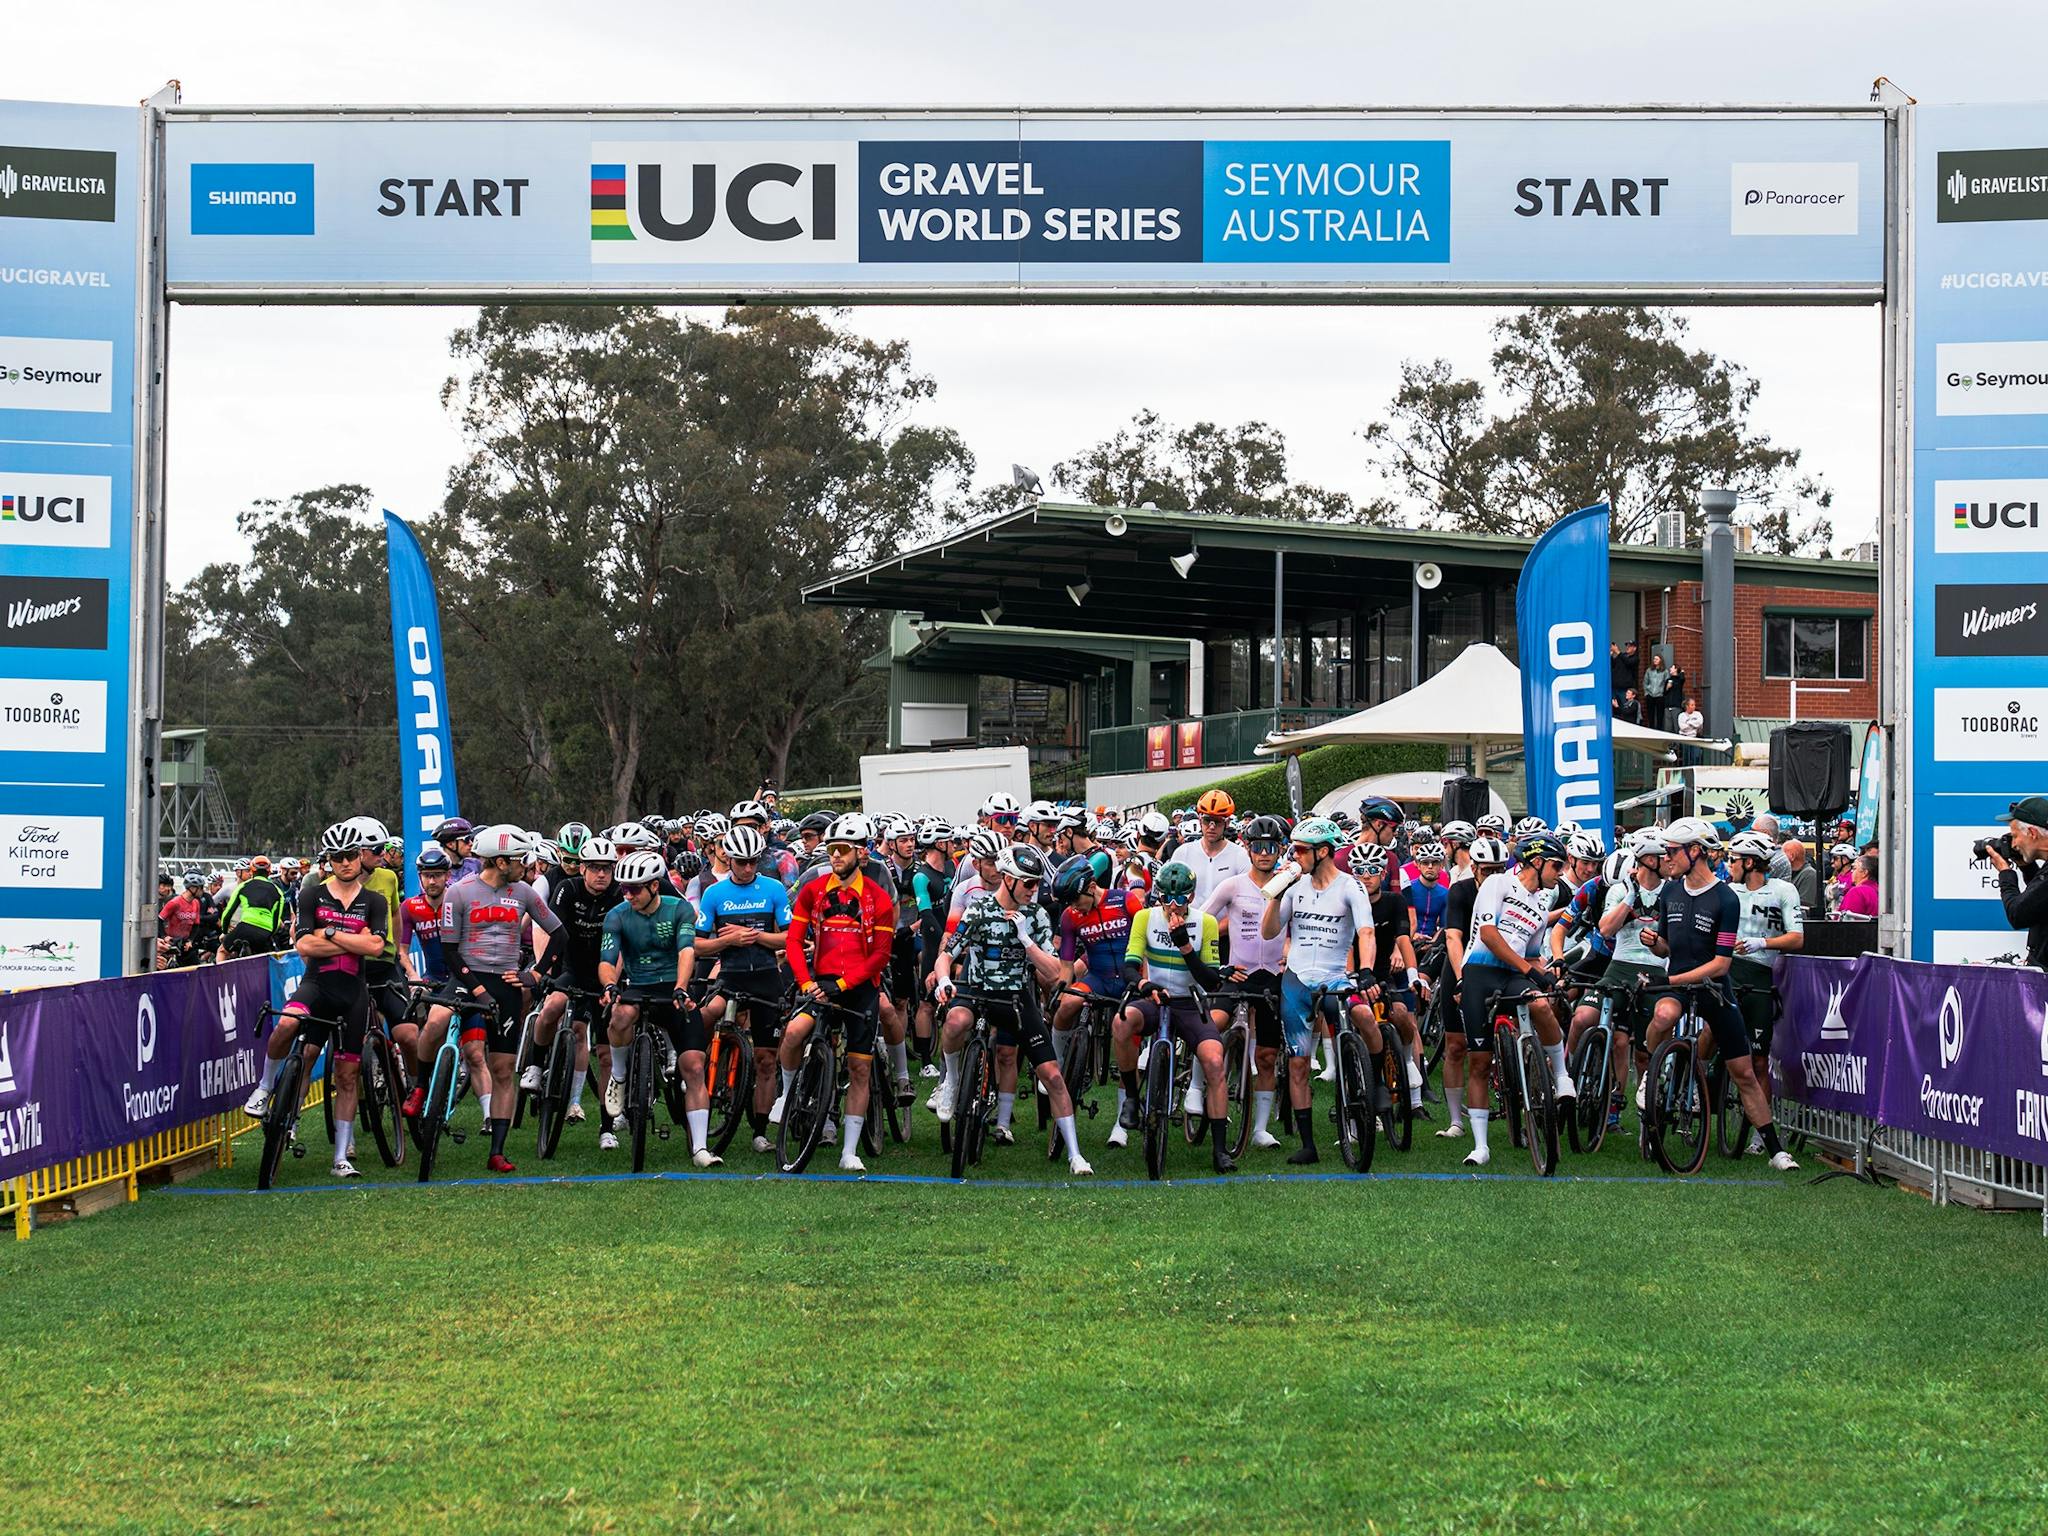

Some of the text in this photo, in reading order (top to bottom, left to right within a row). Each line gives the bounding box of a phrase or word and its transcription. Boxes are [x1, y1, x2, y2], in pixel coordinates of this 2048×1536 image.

[21, 174, 106, 194] GRAVELISTA
[879, 162, 1044, 195] GRAVEL
[1224, 162, 1421, 196] SEYMOUR
[1971, 176, 2048, 194] GRAVELIST
[208, 191, 297, 205] SHIMANO
[377, 178, 529, 217] START
[638, 162, 836, 242] UCI
[1513, 178, 1669, 217] START
[1766, 190, 1845, 205] Panaracer
[878, 208, 1181, 242] WORLD SERIES
[1222, 209, 1431, 242] AUSTRALIA
[0, 267, 111, 288] UCIGRAVEL
[1940, 272, 2048, 289] #UCIGRAVE
[23, 366, 102, 384] Seymour
[1976, 372, 2048, 389] Seymou
[18, 495, 84, 523] UCI
[1970, 502, 2038, 529] UCI
[7, 596, 82, 629] Winners
[1962, 602, 2037, 638] Winners
[5, 707, 80, 724] TOOBORAC
[1962, 717, 2038, 732] TOOBORAC
[18, 825, 61, 843] Ford
[9, 846, 69, 860] Kilmore
[21, 865, 56, 877] Ford
[1293, 910, 1346, 923] GIANT
[1503, 896, 1544, 922] GIANT
[1080, 917, 1128, 936] MAXXIS
[1505, 910, 1537, 930] SRAM
[1921, 1073, 1984, 1127] Panaracer
